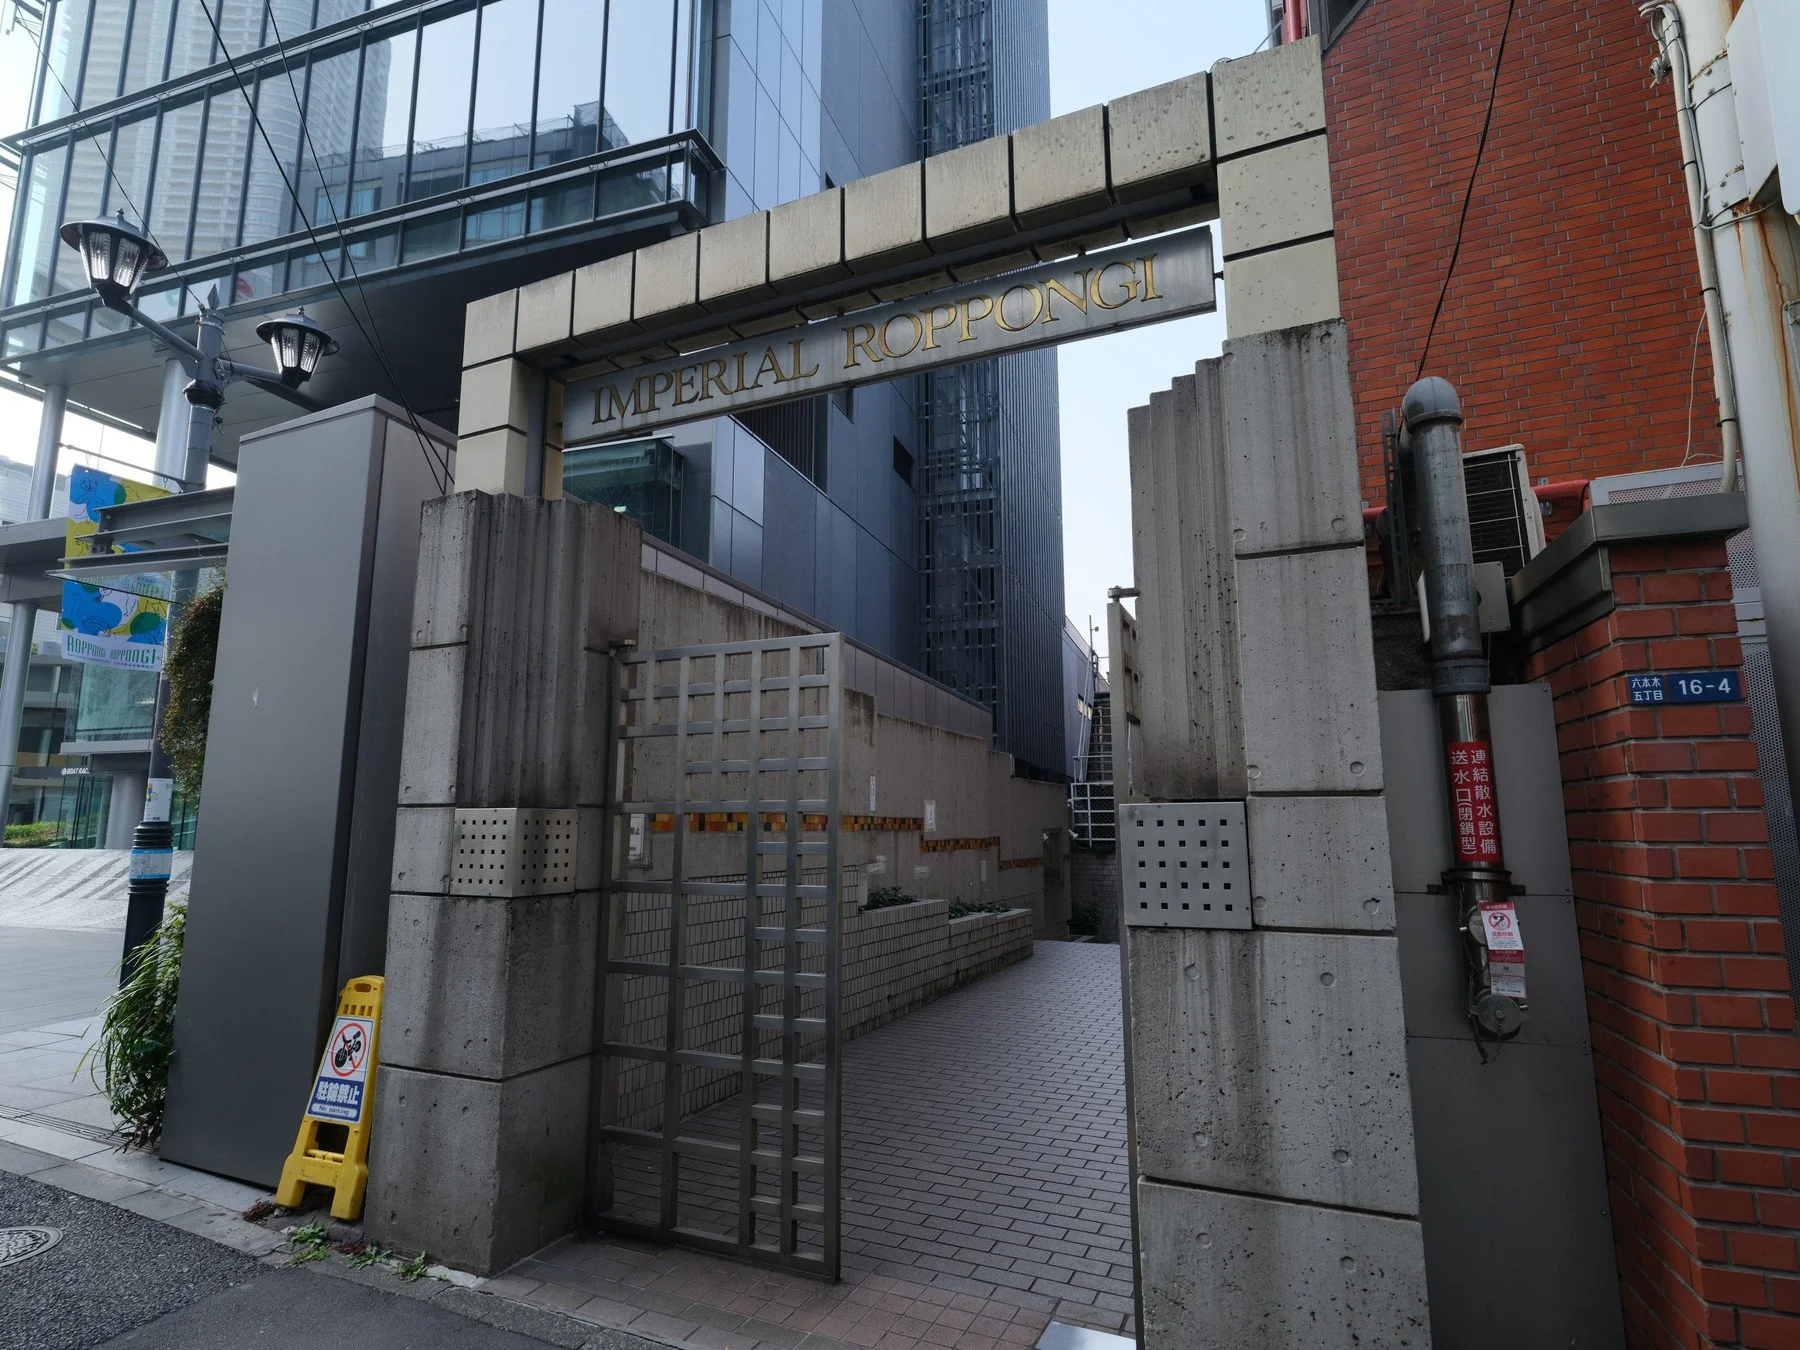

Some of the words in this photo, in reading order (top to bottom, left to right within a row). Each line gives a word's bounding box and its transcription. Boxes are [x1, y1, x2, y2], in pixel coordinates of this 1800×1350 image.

[591, 337, 820, 426] IMPERIAL
[841, 252, 1163, 369] ROPPONGI
[1631, 677, 1661, 689] 六本木
[1678, 677, 1731, 696] 16-4
[1634, 689, 1663, 701] 五丁目
[1471, 749, 1497, 854] 連結散水設備
[316, 1081, 360, 1105] 駐輪禁止
[329, 1107, 350, 1116] parking
